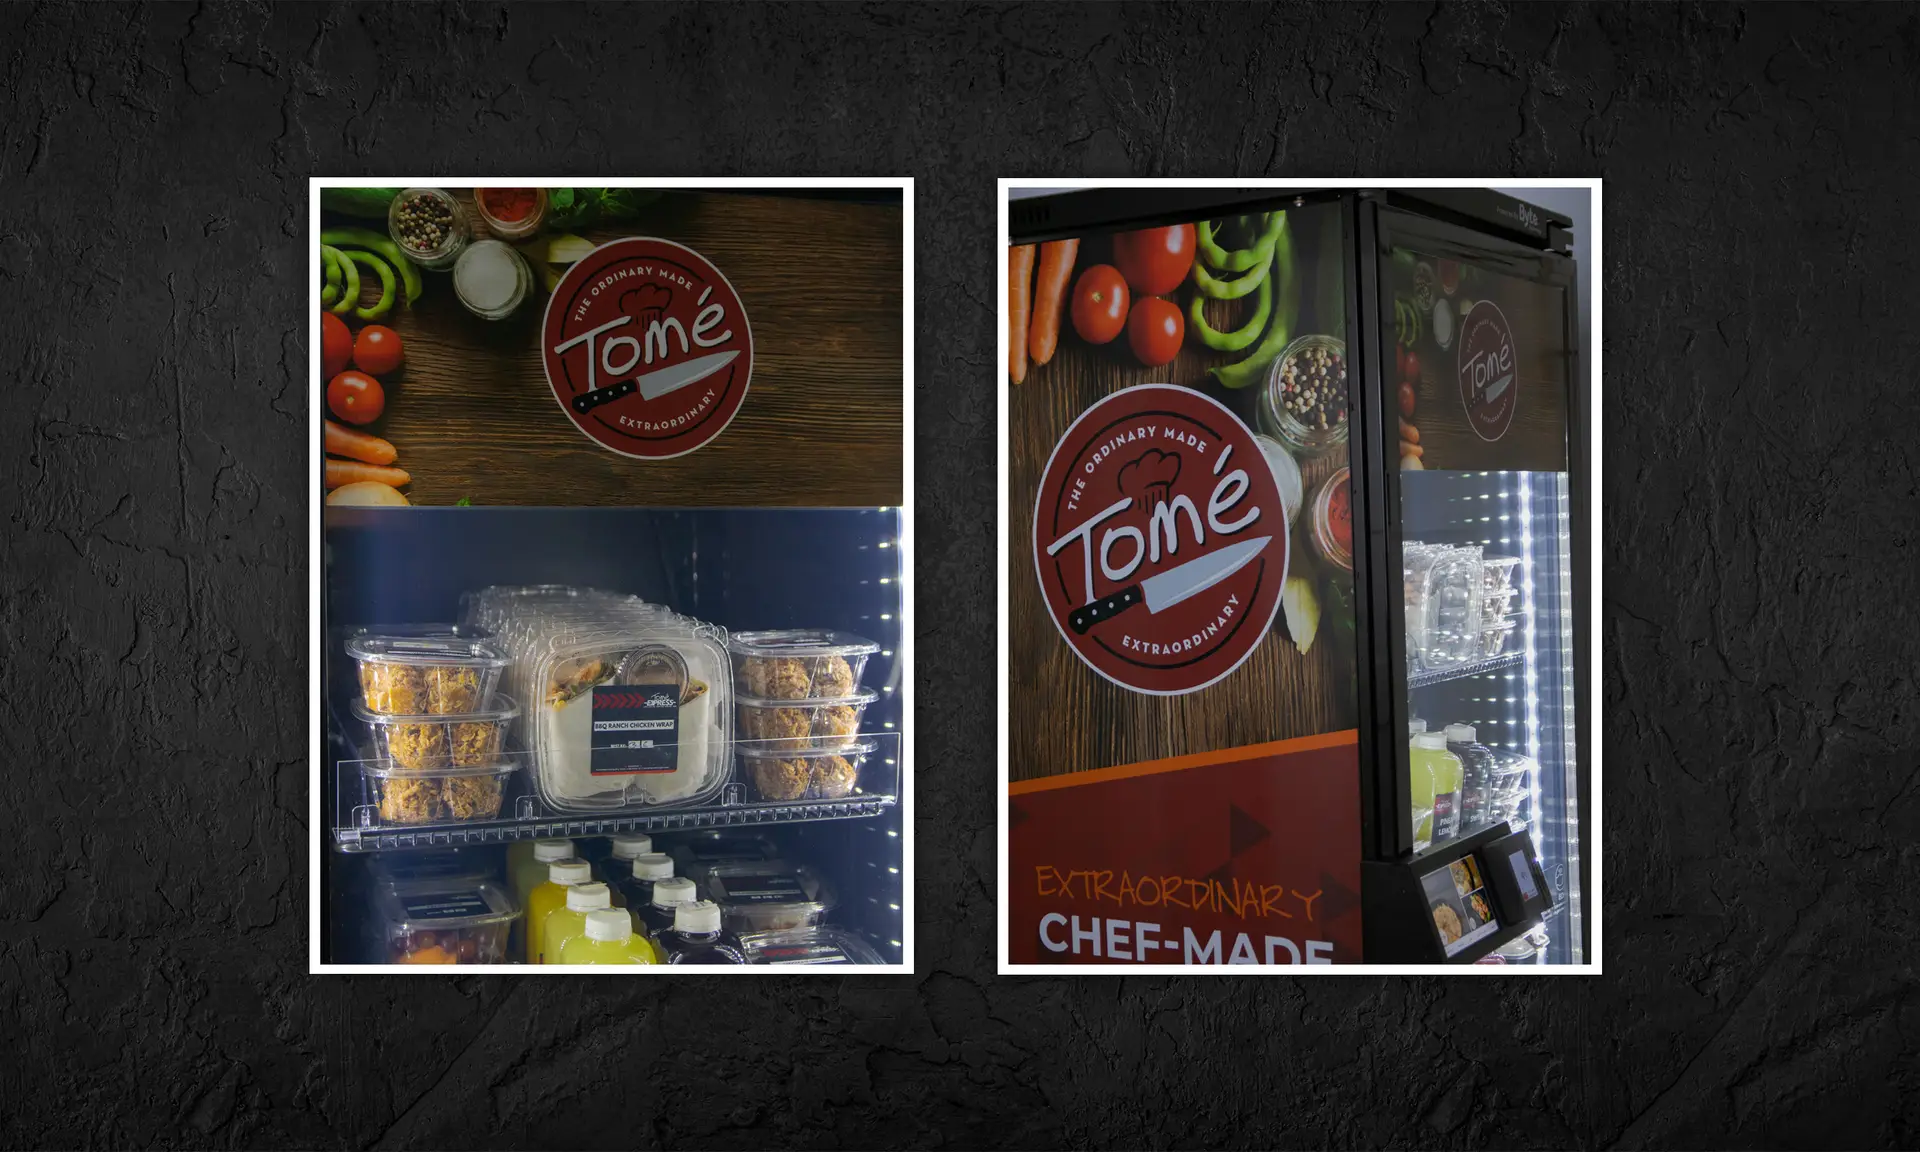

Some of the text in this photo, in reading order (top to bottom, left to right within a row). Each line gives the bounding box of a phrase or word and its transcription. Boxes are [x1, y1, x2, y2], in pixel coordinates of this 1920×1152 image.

[1519, 204, 1539, 227] Byte
[575, 266, 693, 321] THE ORDINARY MADE
[554, 286, 732, 392] Tomé
[1462, 333, 1512, 398] Tomé
[619, 388, 715, 430] EXTRAORDINARY
[1068, 425, 1207, 510] THE ORDINARY MADE
[1047, 444, 1261, 606] Tomé
[1122, 594, 1240, 655] EXTRAORDINARY
[595, 722, 608, 730] BBQ
[608, 721, 628, 729] RANCH
[630, 721, 654, 729] CHICKEN
[1036, 866, 1323, 922] EXTRAORDINARY
[1038, 912, 1334, 965] CHEF-MADE
